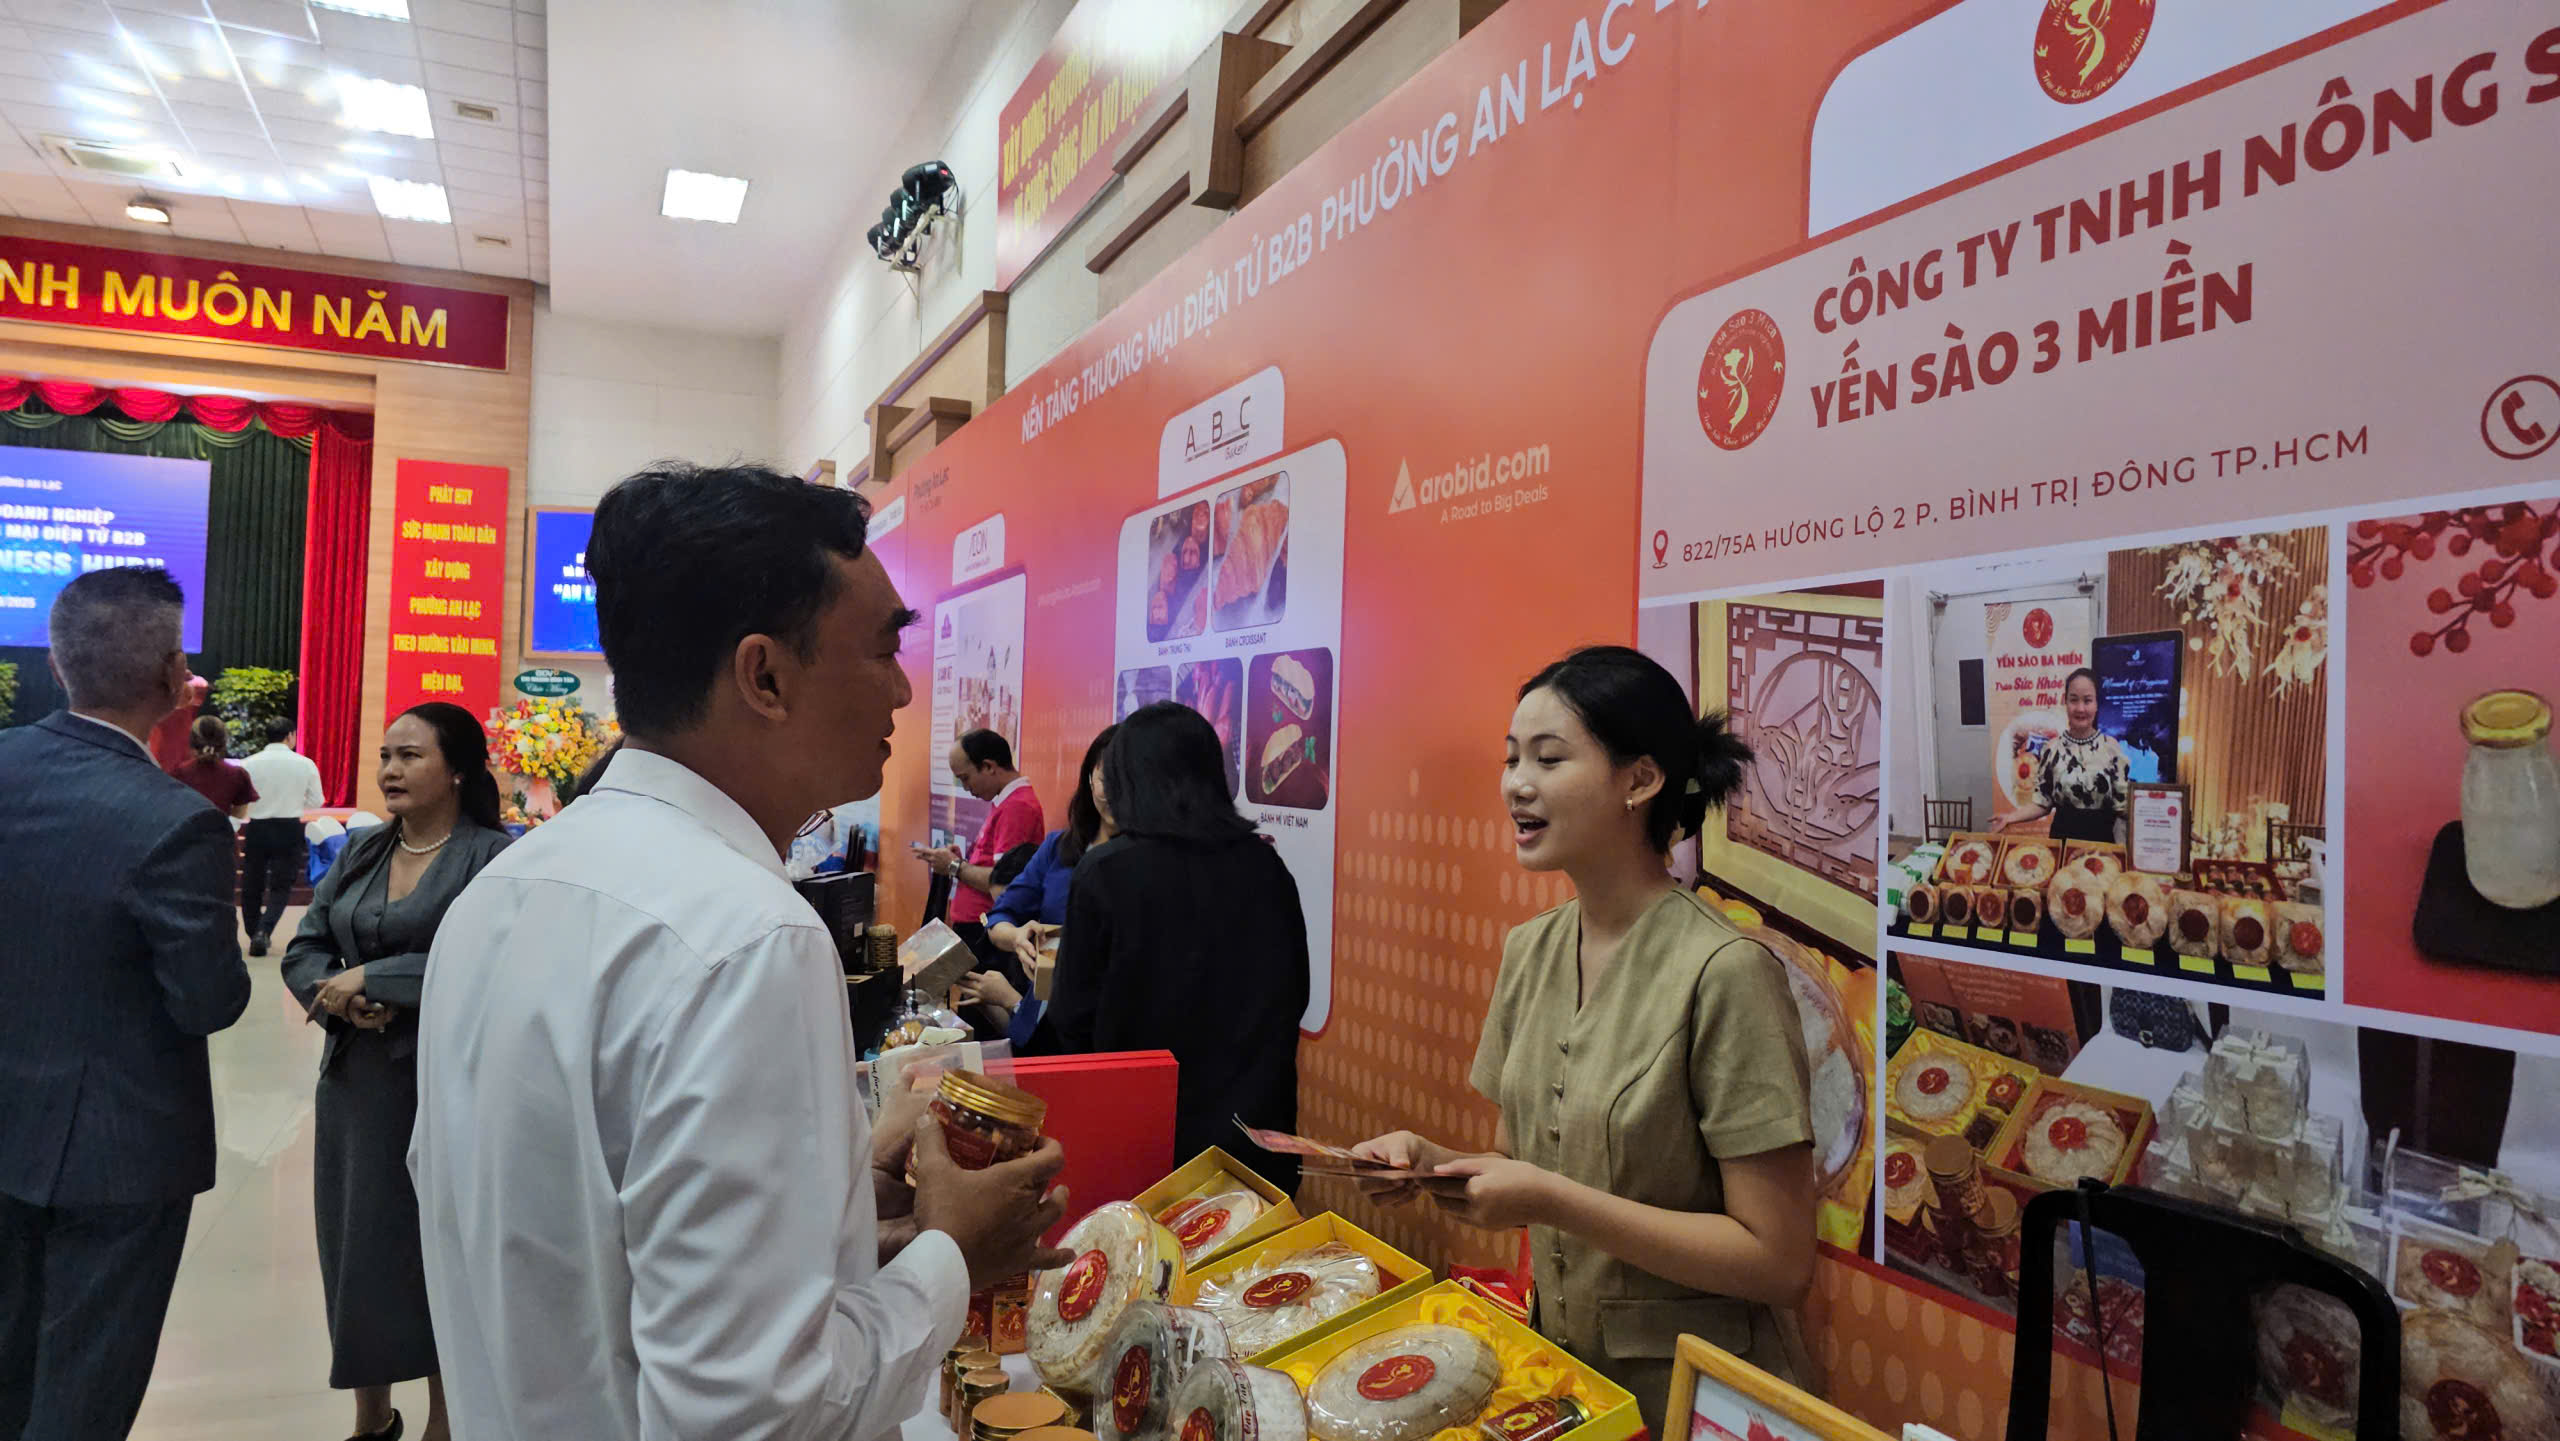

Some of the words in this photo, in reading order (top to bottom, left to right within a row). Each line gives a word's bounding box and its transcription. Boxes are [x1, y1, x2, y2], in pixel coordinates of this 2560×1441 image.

[1046, 379, 1080, 428] TẢNG
[1081, 330, 1144, 405] THƯƠNG
[1147, 303, 1179, 364] MẠI
[1183, 269, 1229, 339] ĐIỆN
[1234, 232, 1265, 304] TỬ
[1268, 212, 1313, 285] B2B
[1320, 110, 1460, 252] PHƯỜNG
[1468, 58, 1528, 157] AN
[1540, 0, 1637, 110] LẠC
[1812, 255, 1944, 335] CÔNG
[1956, 220, 2022, 289] TY
[2032, 148, 2222, 264] TNHH
[2243, 51, 2499, 198] NÔNG
[102, 270, 293, 332] MUÔN
[312, 289, 448, 348] NĂM
[1810, 338, 1898, 428] YẾN
[1910, 321, 2020, 404] SÀO
[2032, 319, 2062, 374] 3
[2077, 238, 2255, 364] MIỀN
[1419, 443, 1551, 505] arobid.com
[1451, 501, 1478, 521] Road
[1480, 498, 1493, 515] to
[1494, 494, 1513, 513] Big
[1515, 483, 1549, 507] Deals
[1682, 532, 1757, 563] 822/75A
[1764, 517, 1845, 550] HƯƠNG
[1854, 505, 1885, 538] LỘ
[1893, 507, 1907, 530] 2
[1916, 502, 1939, 526] P.
[1949, 486, 2020, 521] BÌNH
[2031, 476, 2079, 507] TRỊ
[2091, 456, 2196, 498] ĐÔNG
[2210, 424, 2369, 478] TP.HCM
[5, 523, 40, 542] MẠI
[42, 524, 83, 544] ĐIỆN
[86, 526, 111, 546] TỬ
[111, 530, 147, 547] B2B
[51, 507, 116, 527] NGHIỆP
[2014, 677, 2034, 691] Sức
[2040, 655, 2054, 667] BA
